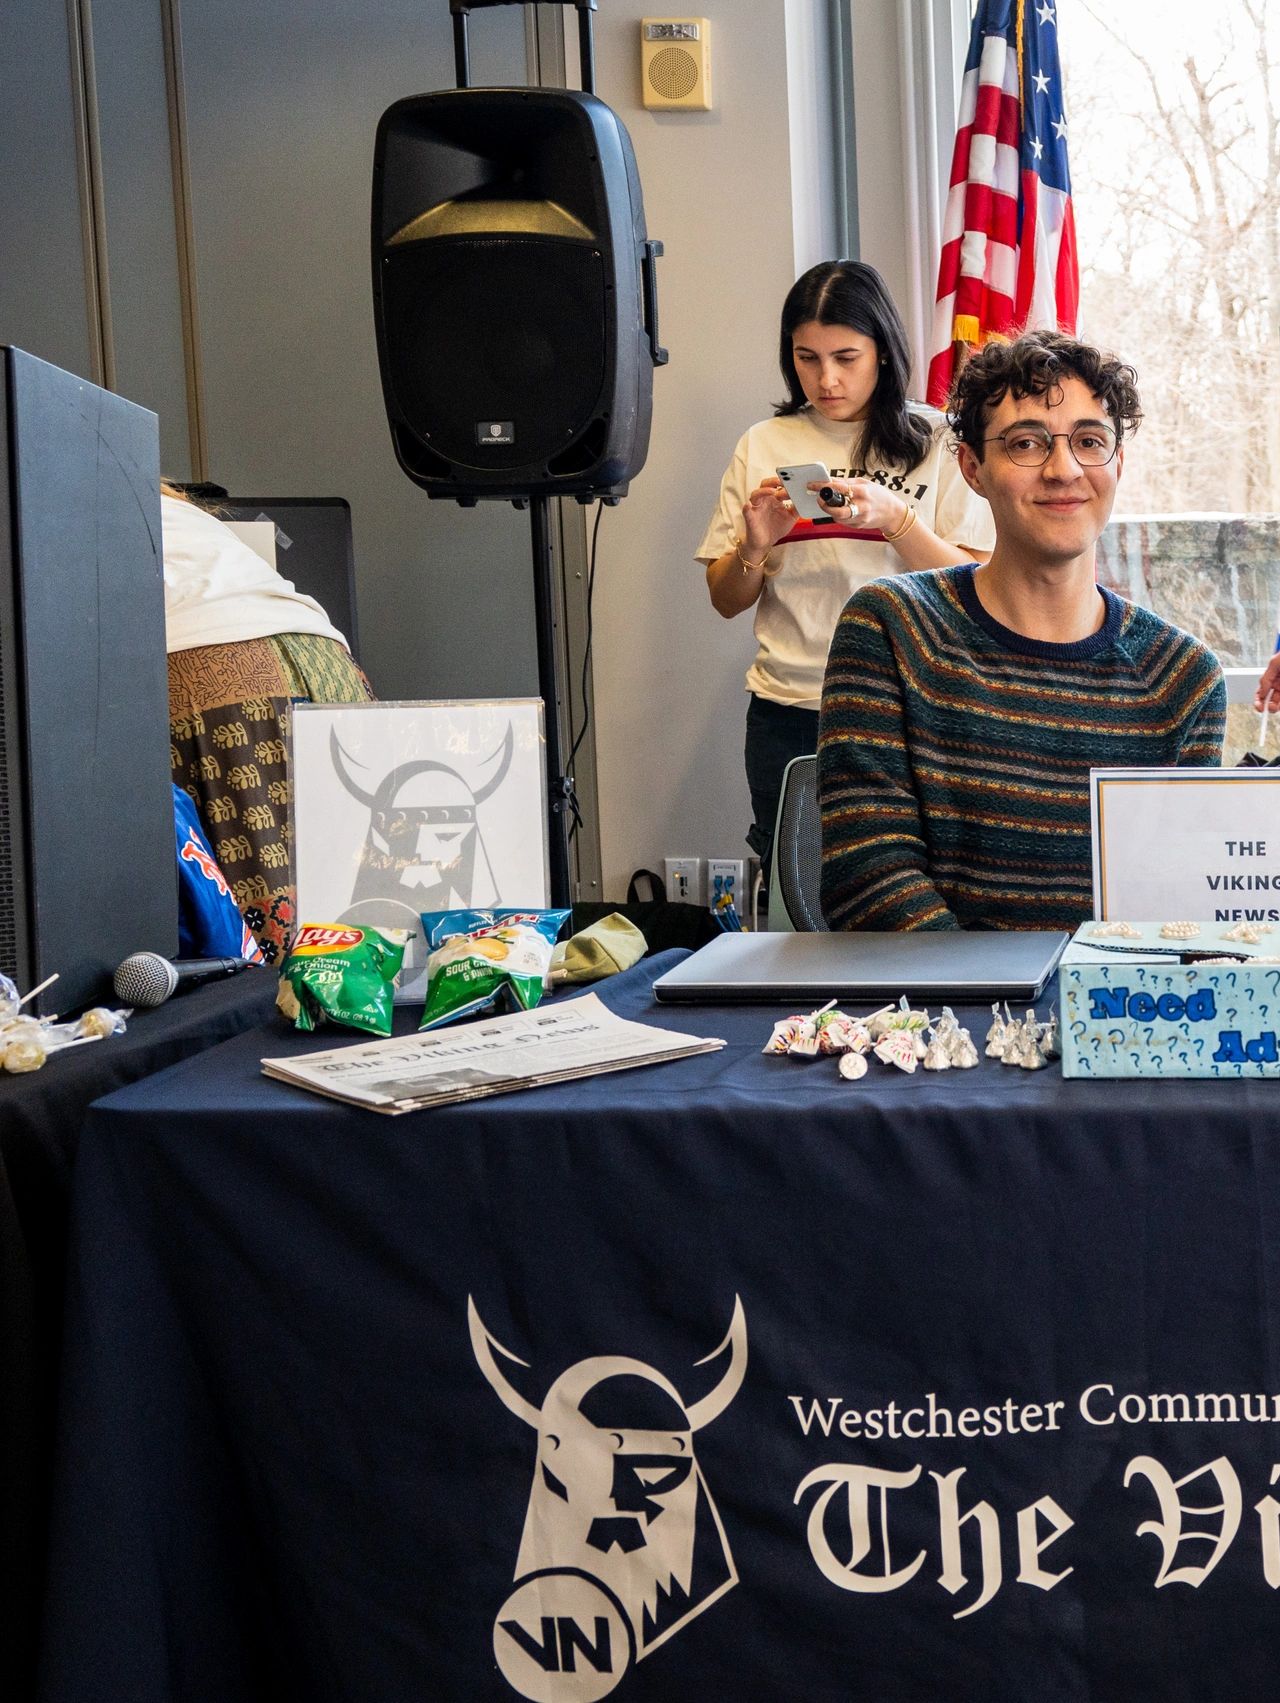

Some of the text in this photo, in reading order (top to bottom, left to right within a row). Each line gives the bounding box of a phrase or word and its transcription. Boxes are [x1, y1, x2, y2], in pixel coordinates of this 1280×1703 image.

[870, 470, 928, 501] 88.1
[1225, 841, 1266, 856] THE
[1215, 909, 1280, 921] NEWS
[446, 960, 471, 977] SOUR
[463, 972, 470, 981] &
[1089, 987, 1217, 1022] Need
[320, 1058, 385, 1072] The
[514, 1024, 600, 1043] News
[788, 1393, 1065, 1439] Westchester
[793, 1463, 1074, 1620] The
[498, 1616, 613, 1673] VN
